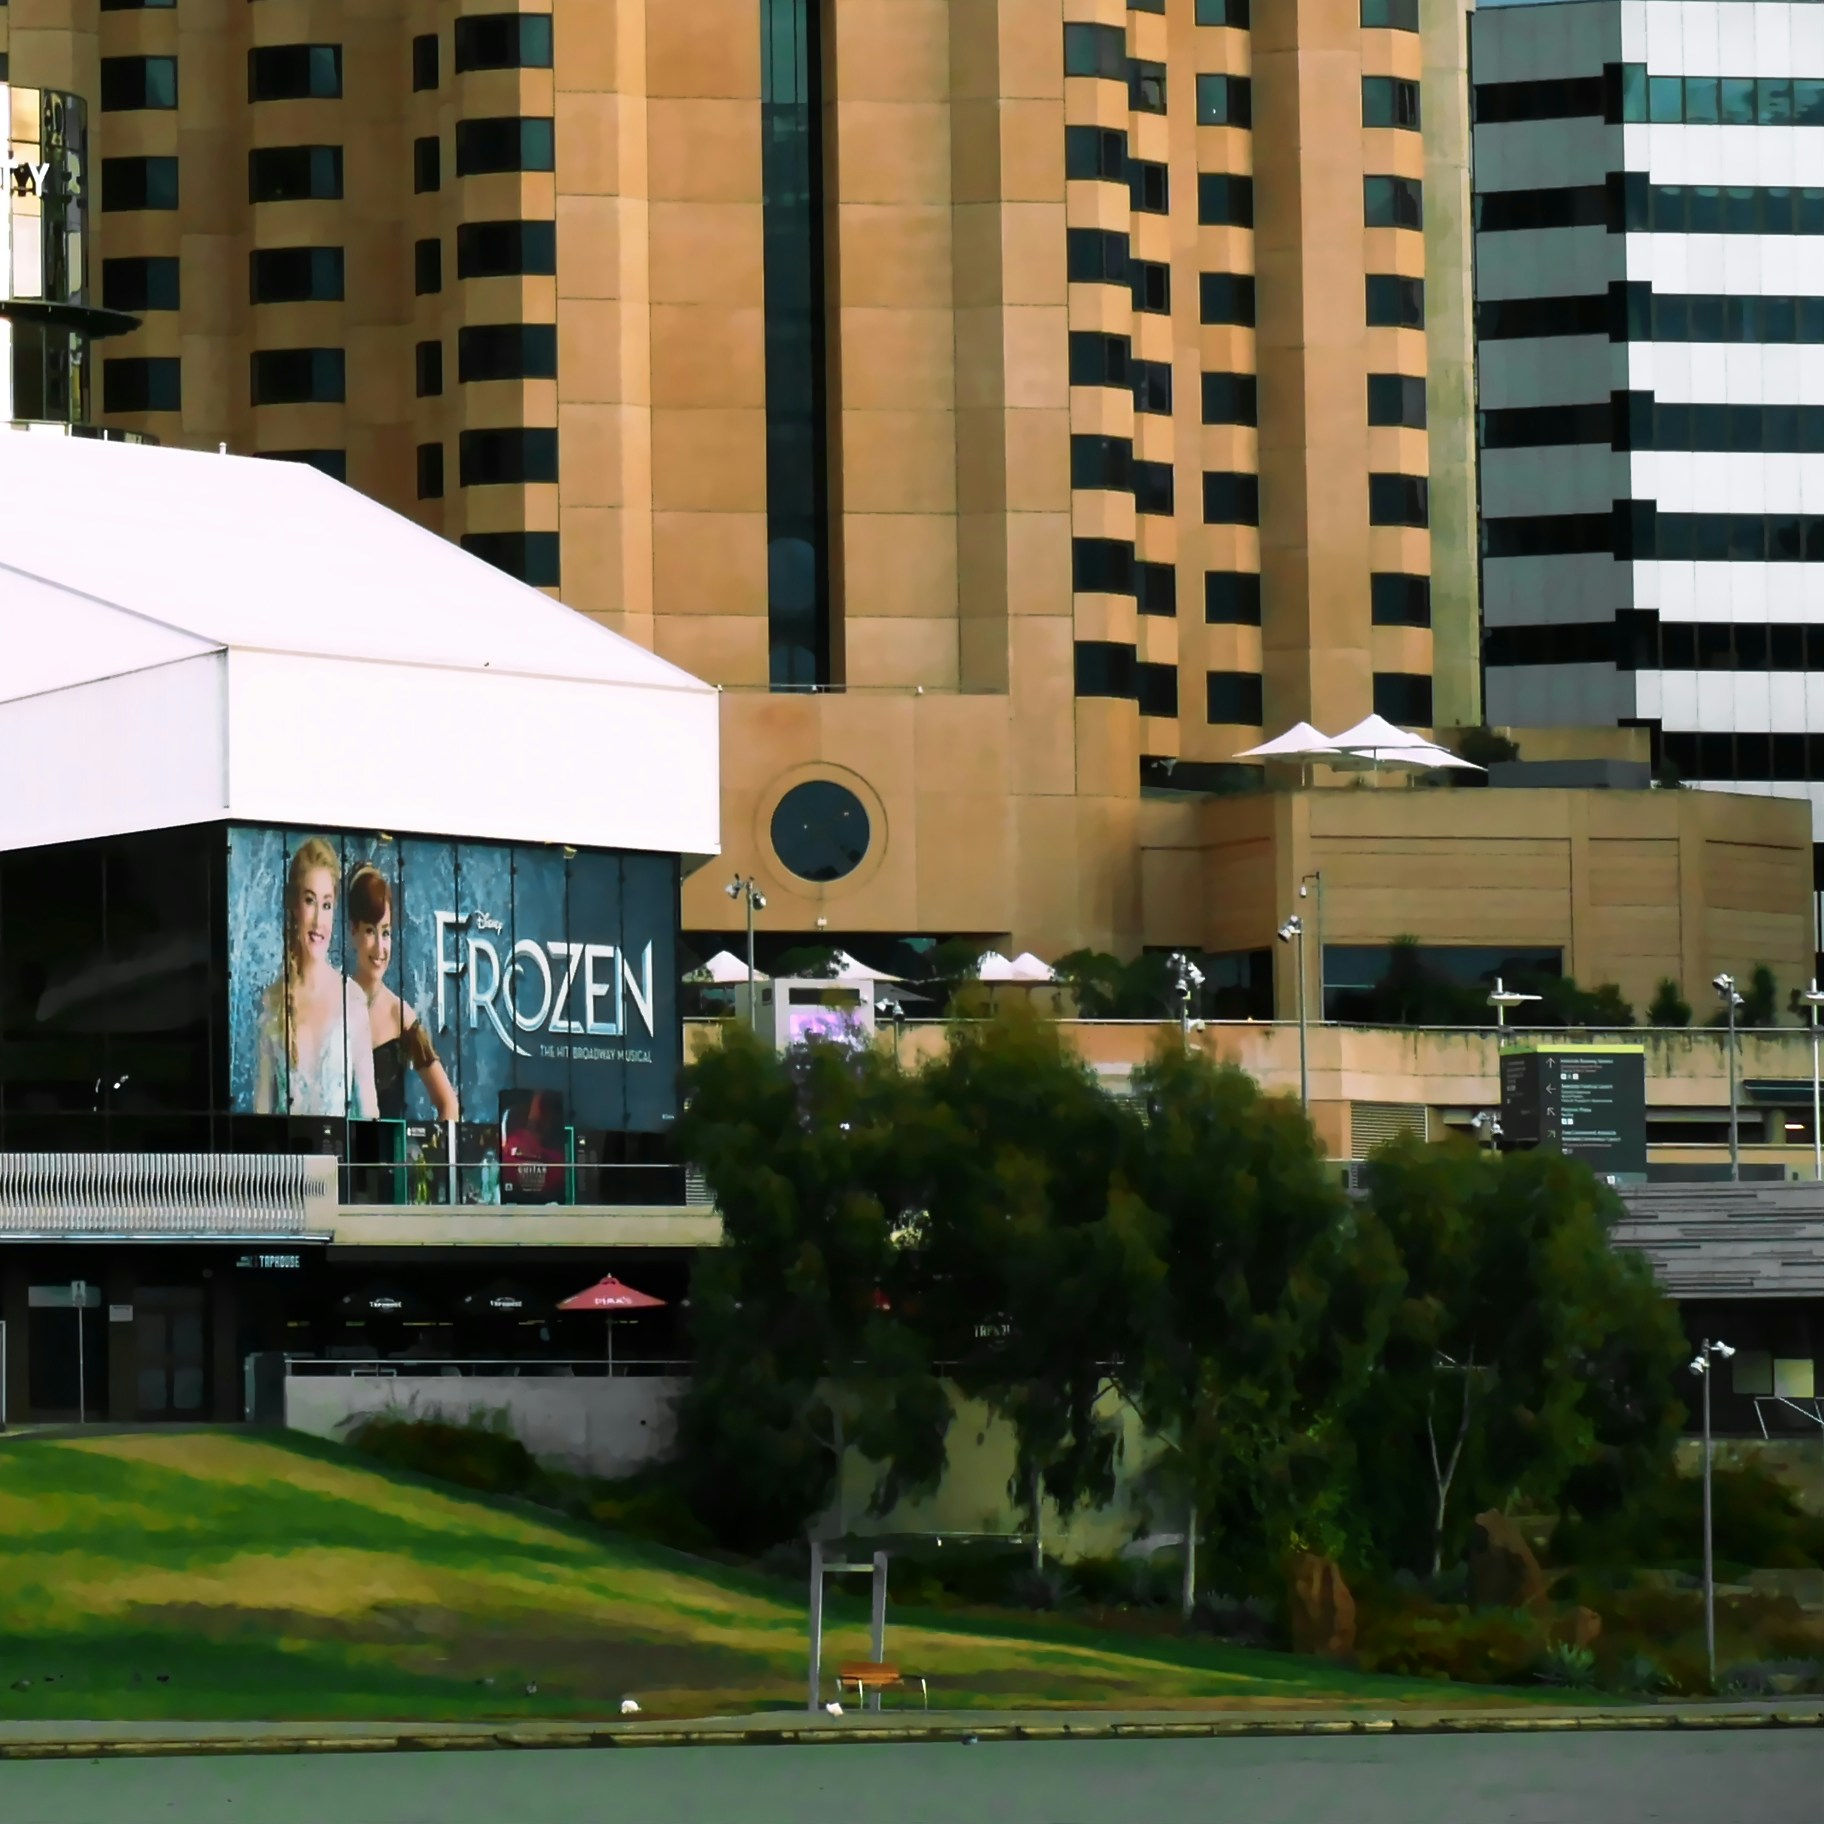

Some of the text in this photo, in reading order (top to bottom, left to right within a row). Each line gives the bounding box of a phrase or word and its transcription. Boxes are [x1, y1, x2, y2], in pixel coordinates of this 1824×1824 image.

[433, 910, 655, 1057] FROZEN
[539, 1044, 555, 1058] THE
[572, 1046, 616, 1061] BROADWAY
[617, 1049, 653, 1064] MUSICAL
